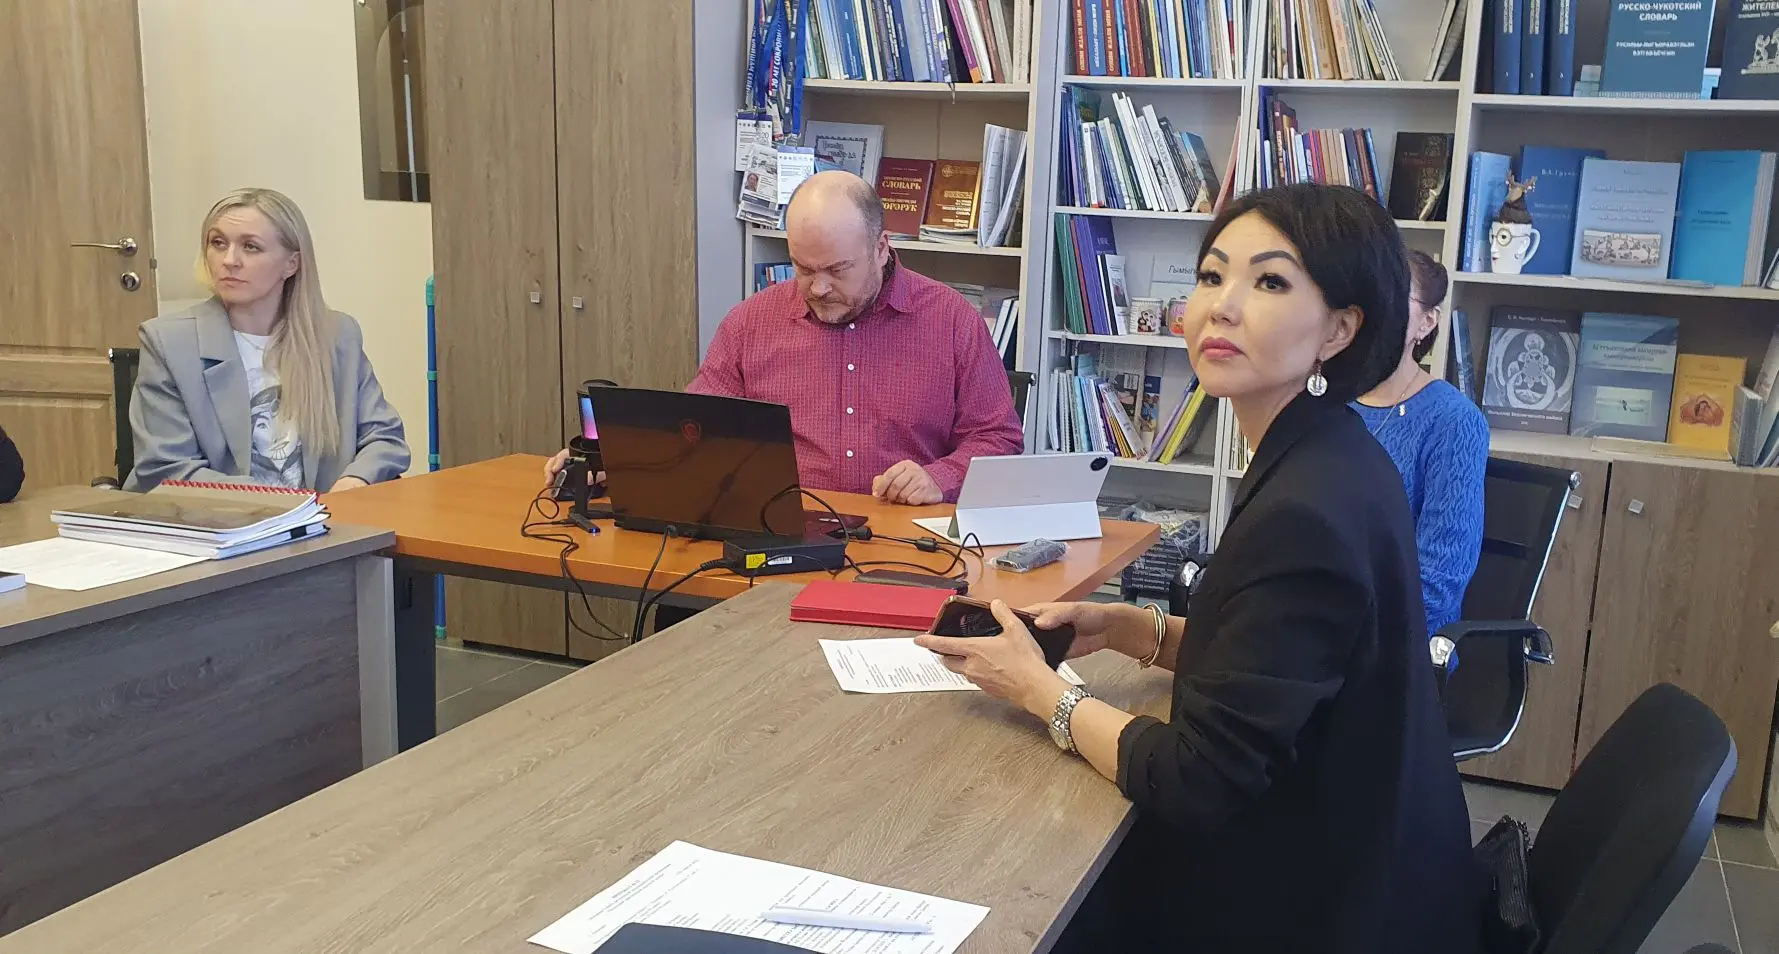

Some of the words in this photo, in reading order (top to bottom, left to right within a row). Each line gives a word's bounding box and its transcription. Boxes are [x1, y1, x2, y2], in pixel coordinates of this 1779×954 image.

[1618, 1, 1702, 11] РУССКО-ЧУКОТСКИЙ
[1639, 12, 1678, 21] СЛОВАРЬ
[882, 181, 921, 190] СЛОВАРЬ
